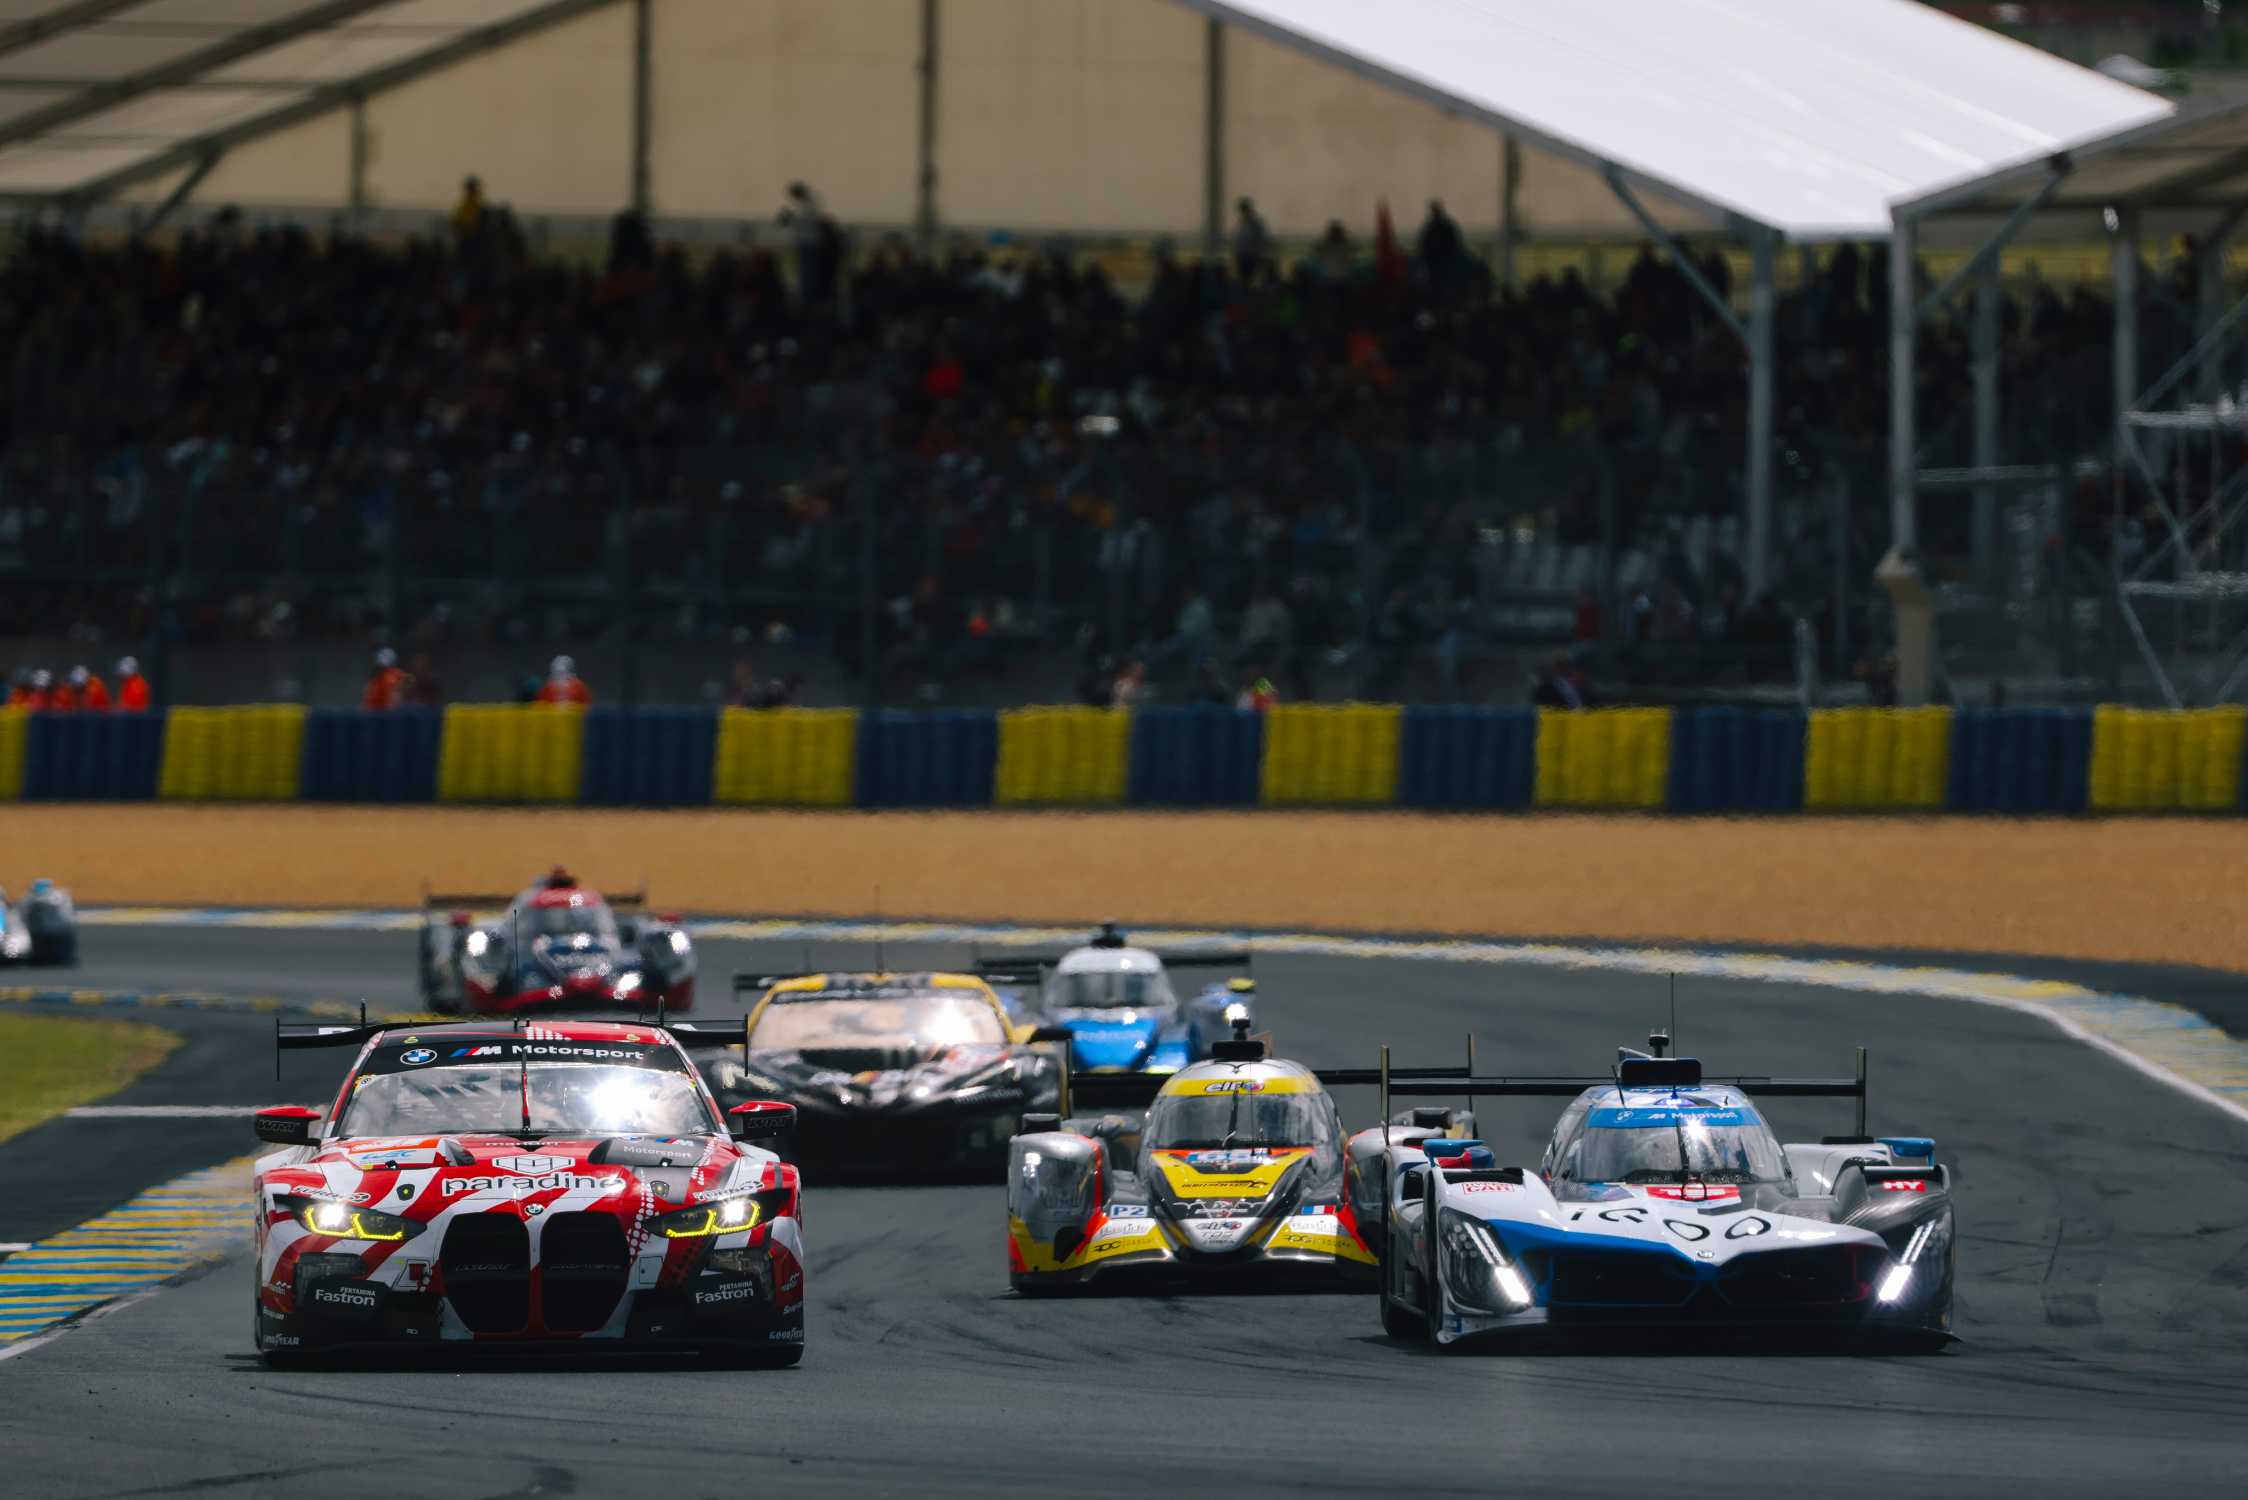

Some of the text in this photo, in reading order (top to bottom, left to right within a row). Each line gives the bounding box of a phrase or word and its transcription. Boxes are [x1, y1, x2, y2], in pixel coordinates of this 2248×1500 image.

[511, 1045, 644, 1060] Motorsport
[623, 1145, 693, 1159] Motorsport
[443, 1172, 625, 1196] paradine
[1113, 1205, 1145, 1216] P2
[315, 1288, 376, 1306] Fastron
[695, 1287, 754, 1304] Fastron
